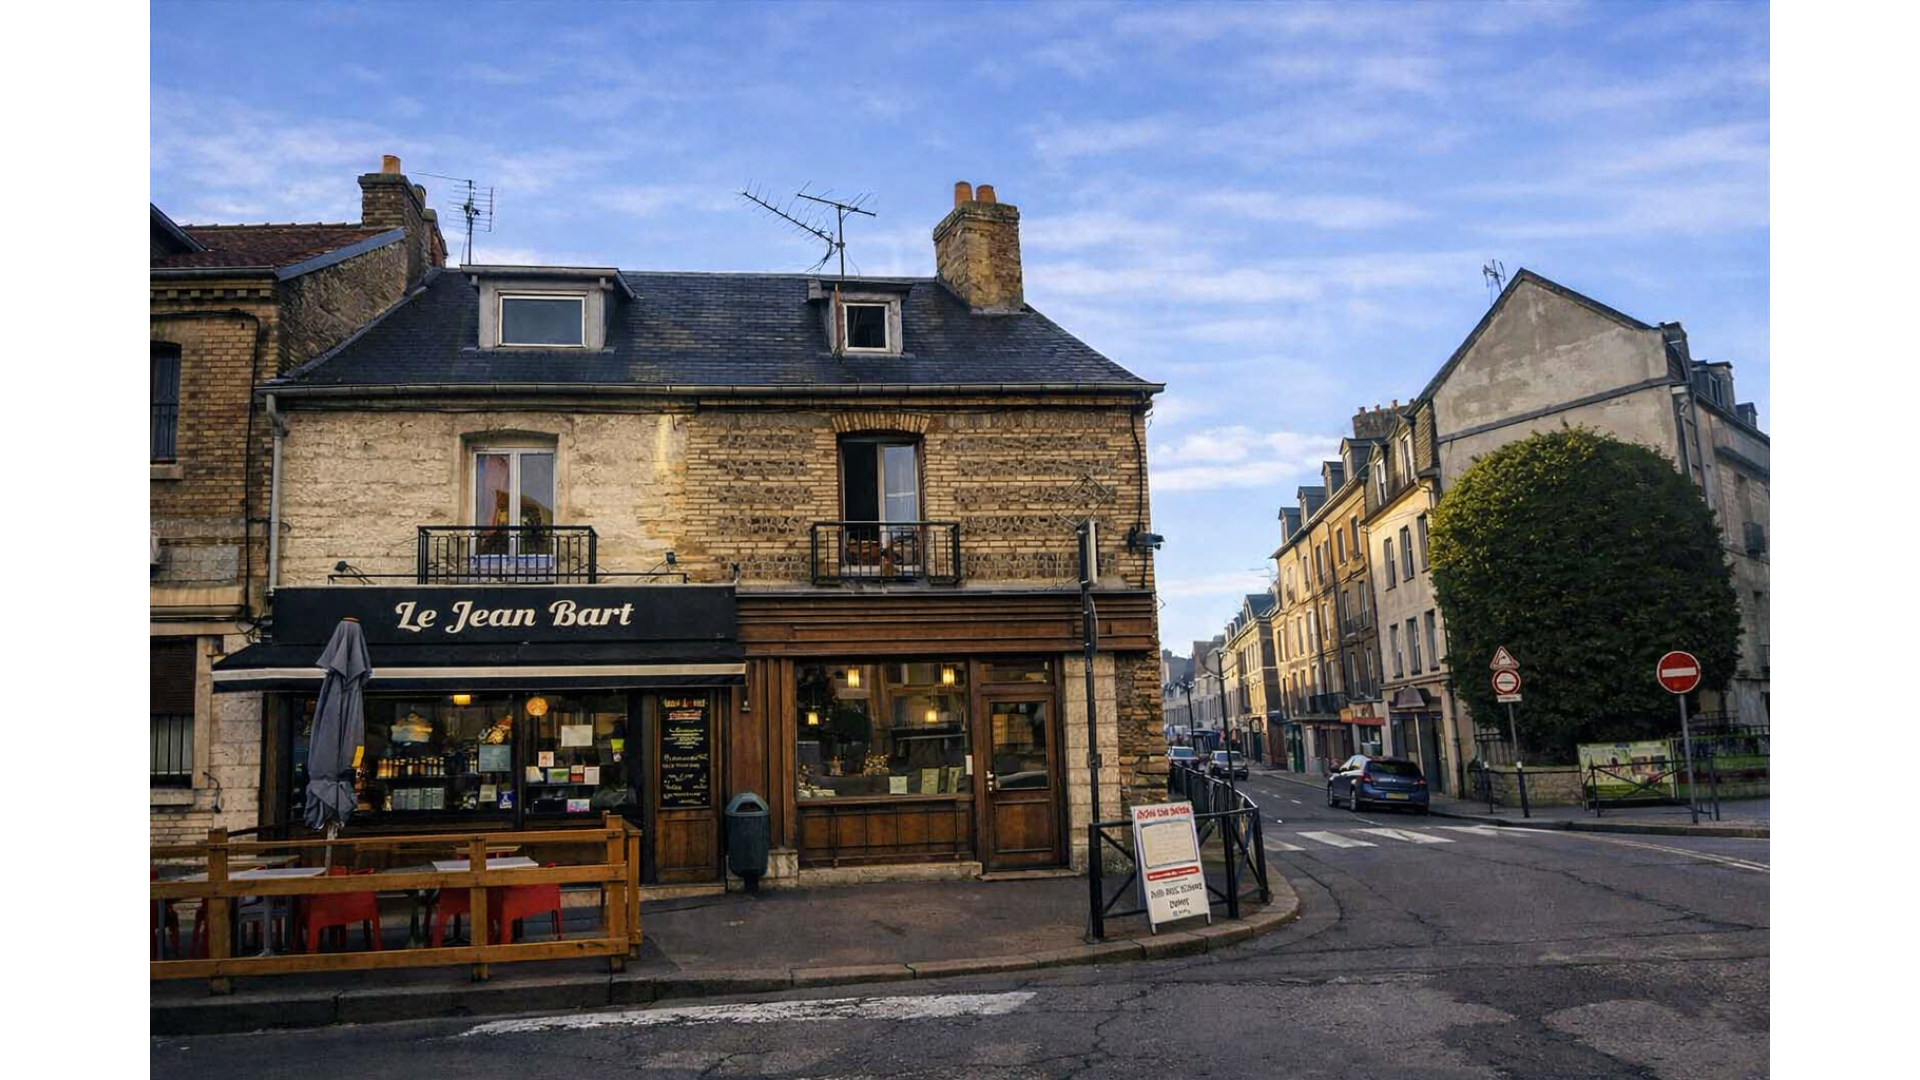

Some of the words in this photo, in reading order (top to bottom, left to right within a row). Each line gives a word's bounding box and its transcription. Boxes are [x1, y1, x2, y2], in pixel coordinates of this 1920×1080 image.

[395, 601, 437, 632] Le
[445, 600, 535, 633] Jean
[548, 599, 635, 627] Bart
